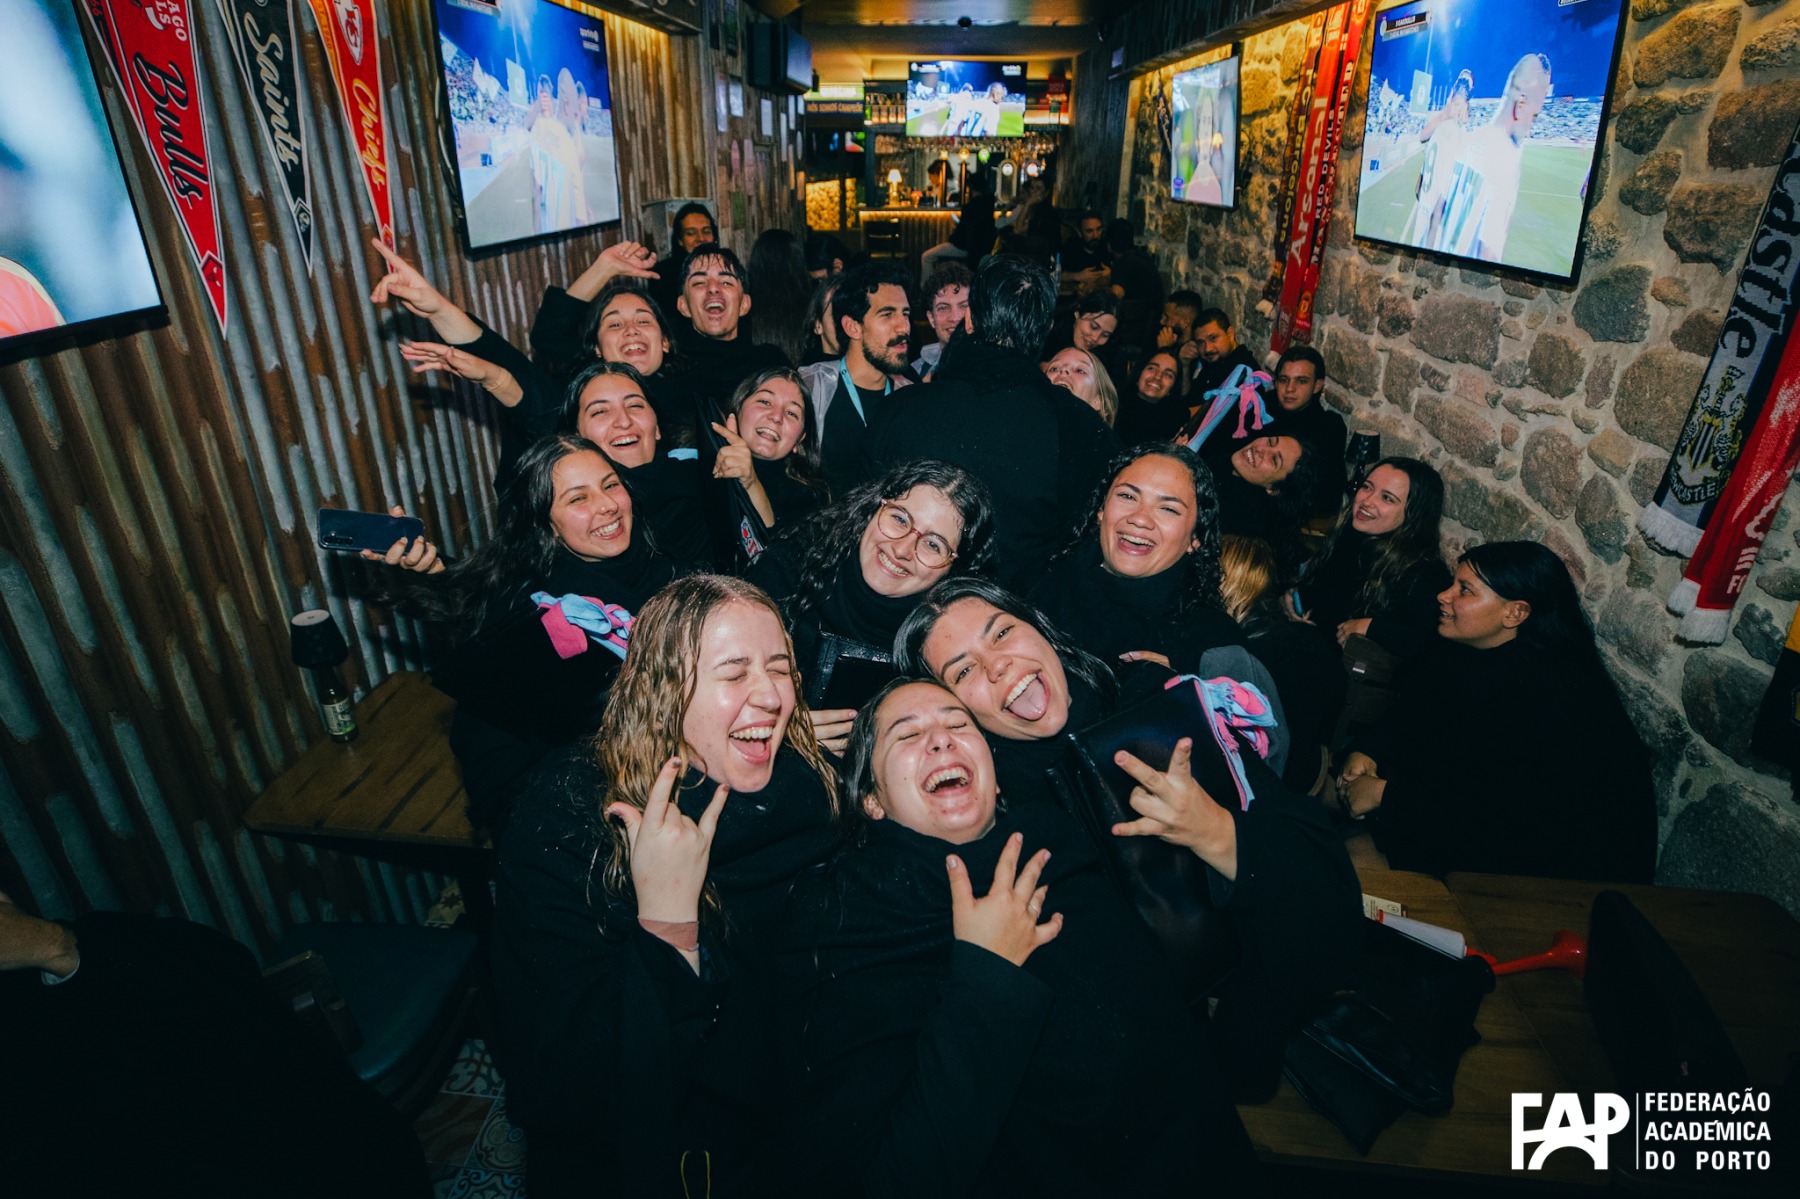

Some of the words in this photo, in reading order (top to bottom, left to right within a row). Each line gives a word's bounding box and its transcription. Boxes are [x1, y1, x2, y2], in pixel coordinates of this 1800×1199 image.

[133, 51, 209, 210] Bulls
[244, 11, 301, 172] Saints
[352, 77, 386, 191] Chiefs
[1316, 183, 1325, 219] RED
[1321, 109, 1335, 175] DEVILS
[1280, 115, 1306, 243] Barcelona
[1291, 97, 1328, 268] Arsenal
[1718, 135, 1800, 358] castle
